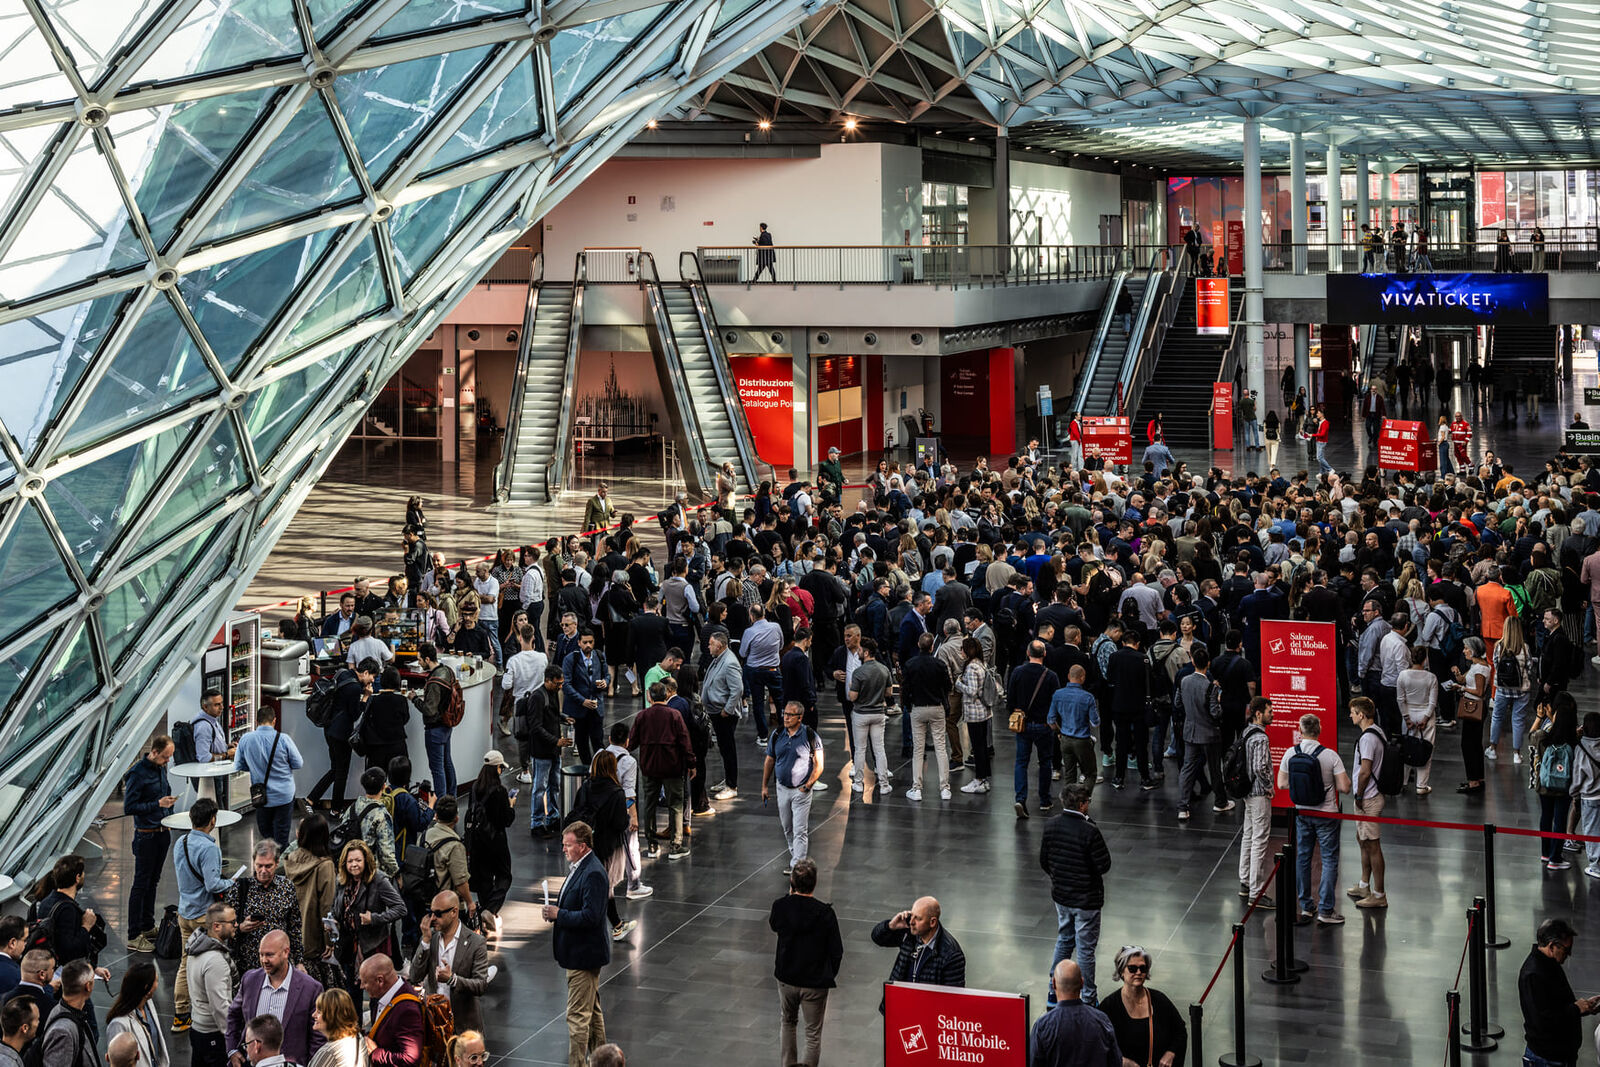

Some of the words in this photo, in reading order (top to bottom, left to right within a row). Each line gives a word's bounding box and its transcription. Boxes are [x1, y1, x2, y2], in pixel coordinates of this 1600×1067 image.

[1381, 293, 1492, 306] VIVATICKET
[740, 389, 779, 398] Cataloghi
[742, 399, 778, 408] Catalogue
[1290, 632, 1314, 641] Salone
[1303, 641, 1328, 649] Mobile.
[1290, 648, 1315, 656] Milano
[938, 1014, 982, 1032] Salone
[938, 1031, 958, 1045] del
[961, 1032, 1010, 1050] Mobile.
[938, 1045, 984, 1063] Milano
